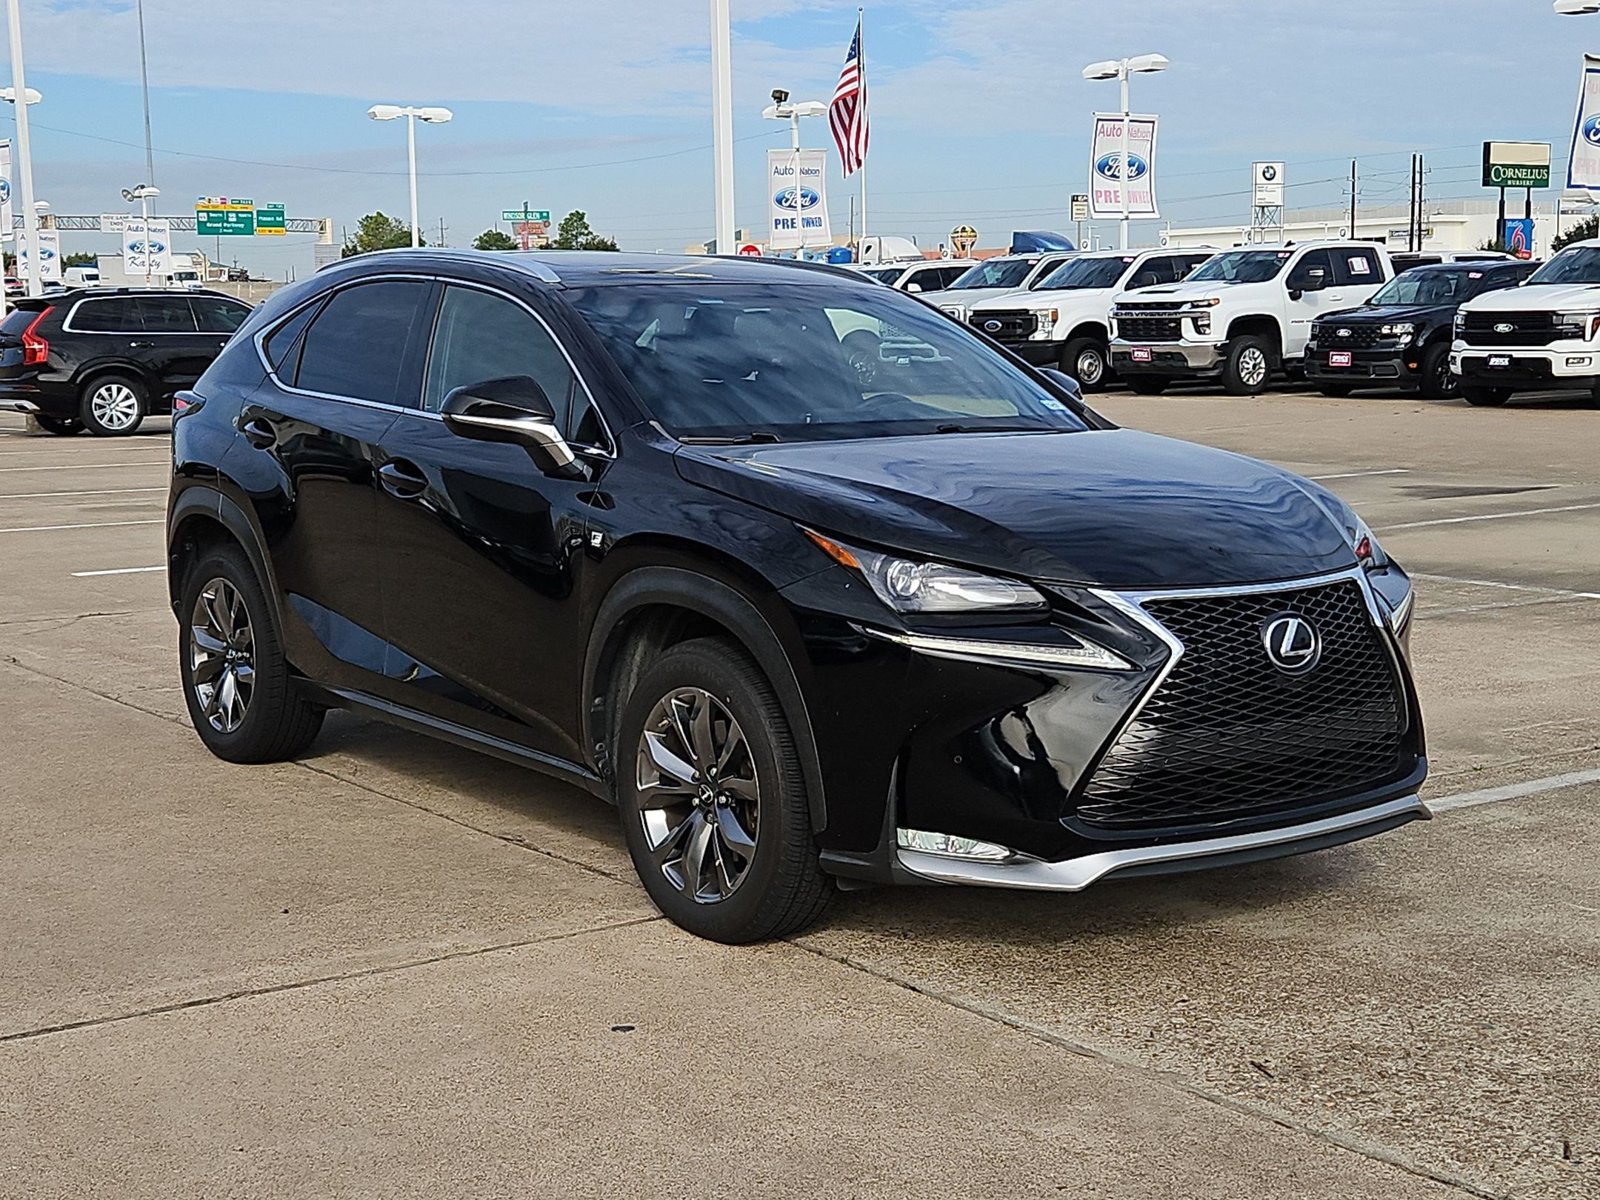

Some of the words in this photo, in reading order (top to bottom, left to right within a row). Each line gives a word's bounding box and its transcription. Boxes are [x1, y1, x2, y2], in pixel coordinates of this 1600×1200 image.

[1098, 123, 1122, 137] Auto
[773, 165, 794, 176] Auto
[1104, 156, 1139, 176] Fod
[1491, 165, 1548, 182] CORNELIUS
[1095, 190, 1120, 204] PRE
[774, 217, 797, 230] PRE
[134, 242, 159, 252] Fod
